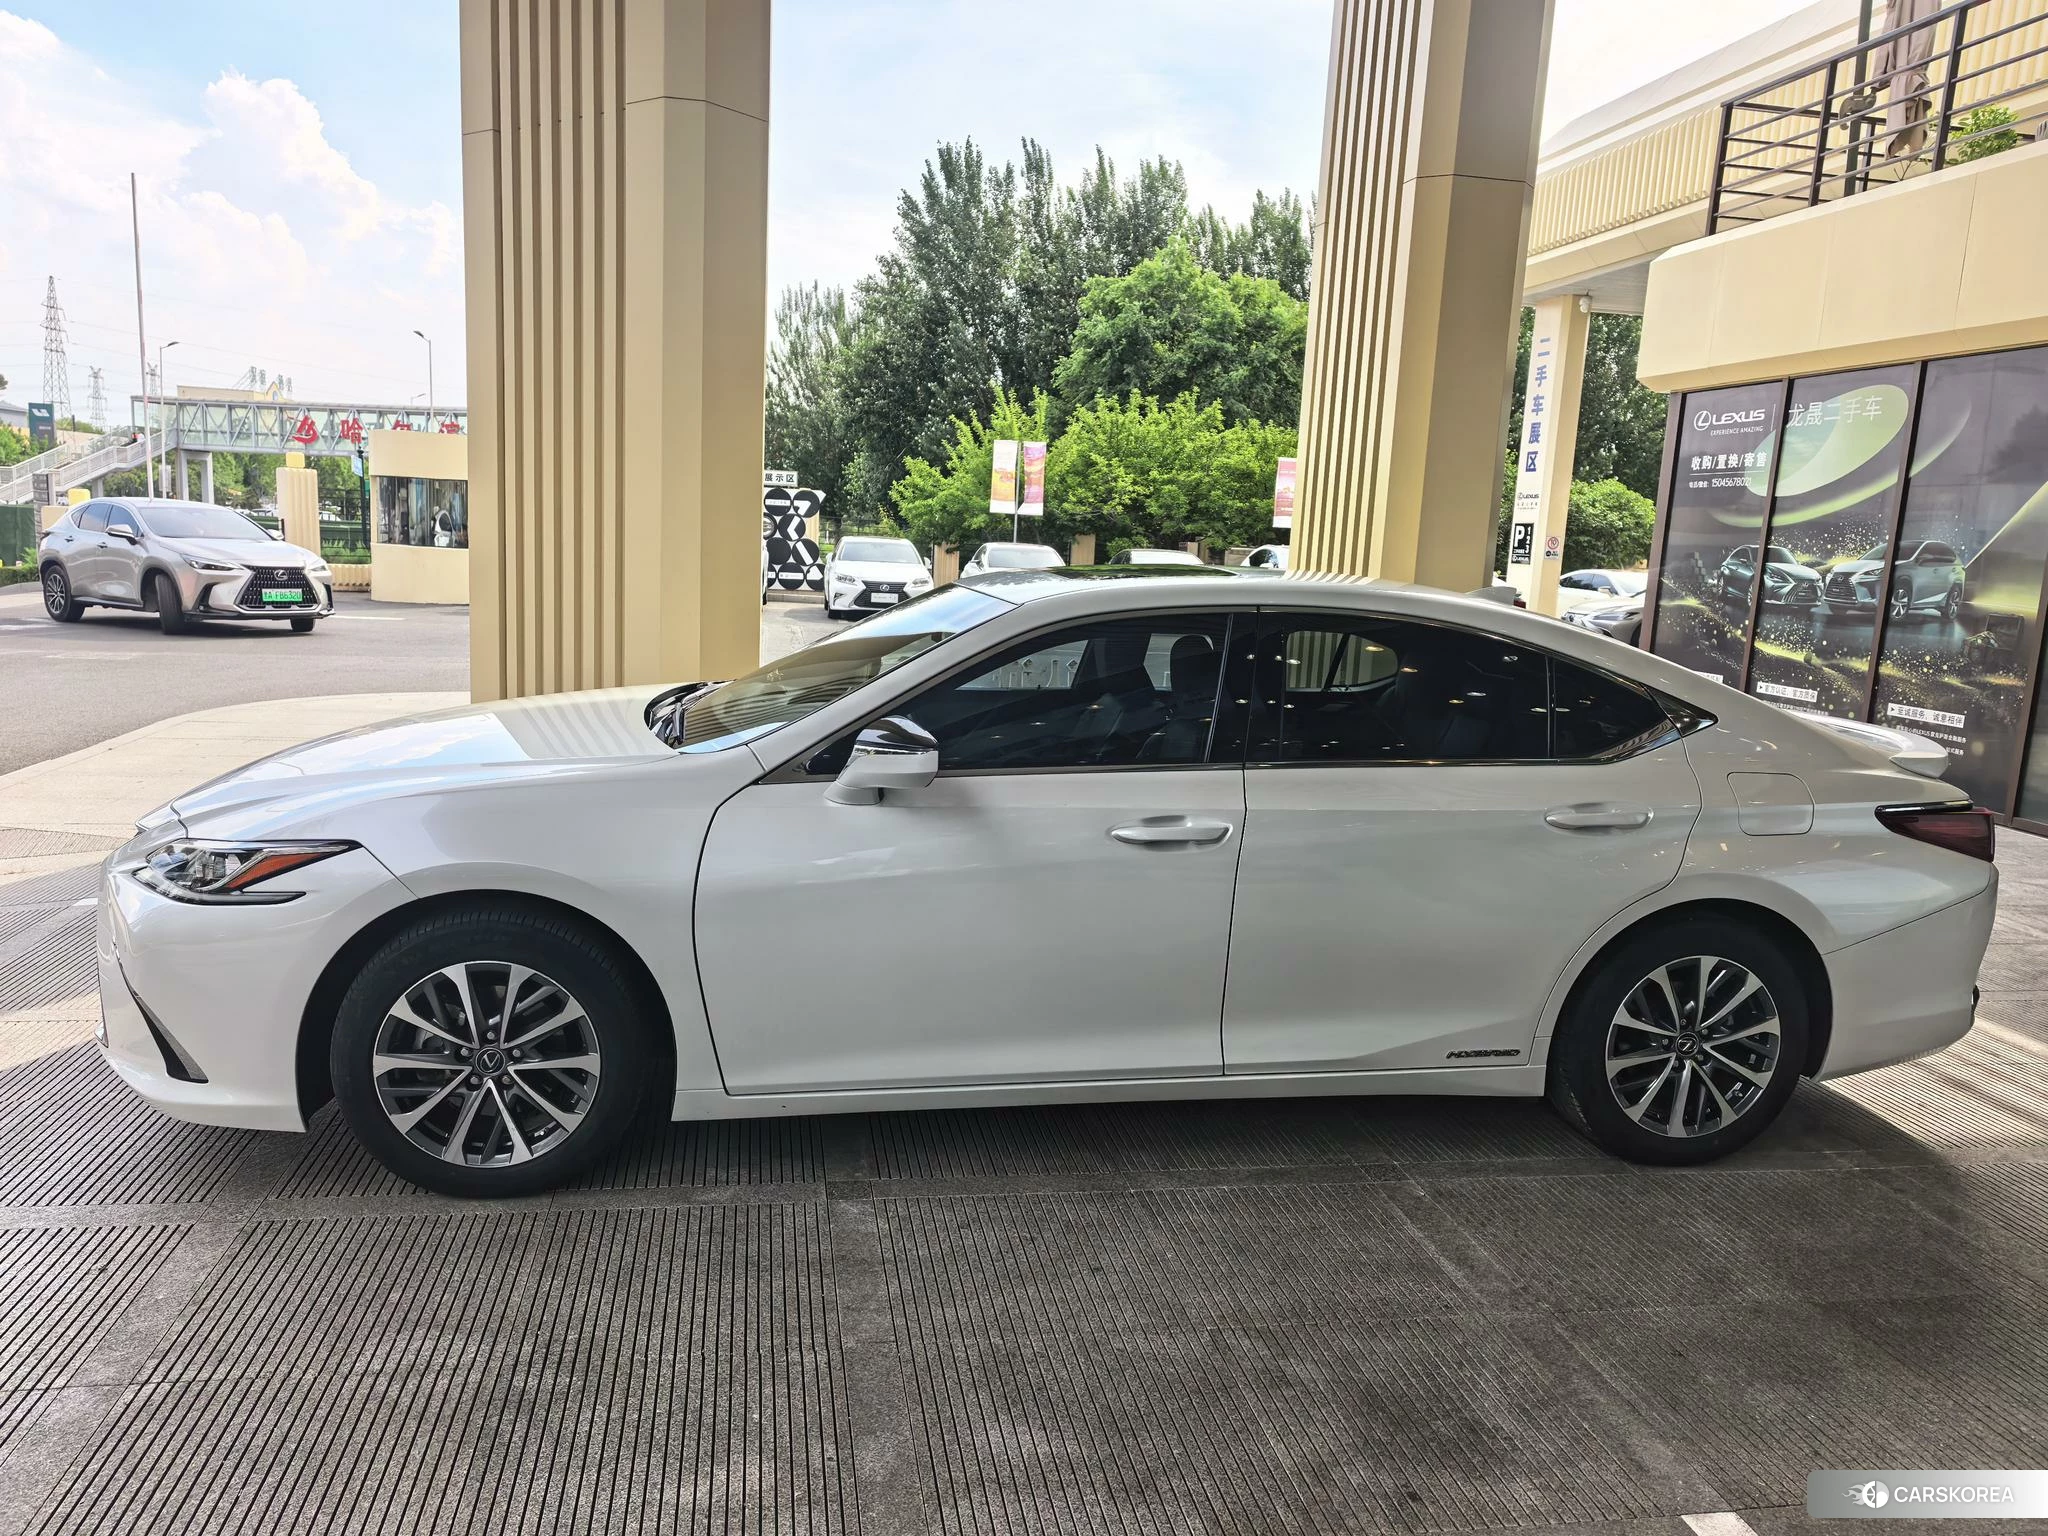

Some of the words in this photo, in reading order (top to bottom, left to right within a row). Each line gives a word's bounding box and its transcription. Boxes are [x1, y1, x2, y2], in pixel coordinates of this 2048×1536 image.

[1525, 337, 1550, 472] 二手车展区
[1786, 395, 1883, 428] 龙晟二手车
[1712, 409, 1766, 426] LEXUS
[1710, 428, 1740, 437] EXPERIENCE
[1740, 425, 1764, 434] AMAZING
[1691, 452, 1768, 471] 收购/置换/寄售
[764, 473, 795, 483] 展示区
[1513, 525, 1526, 548] P
